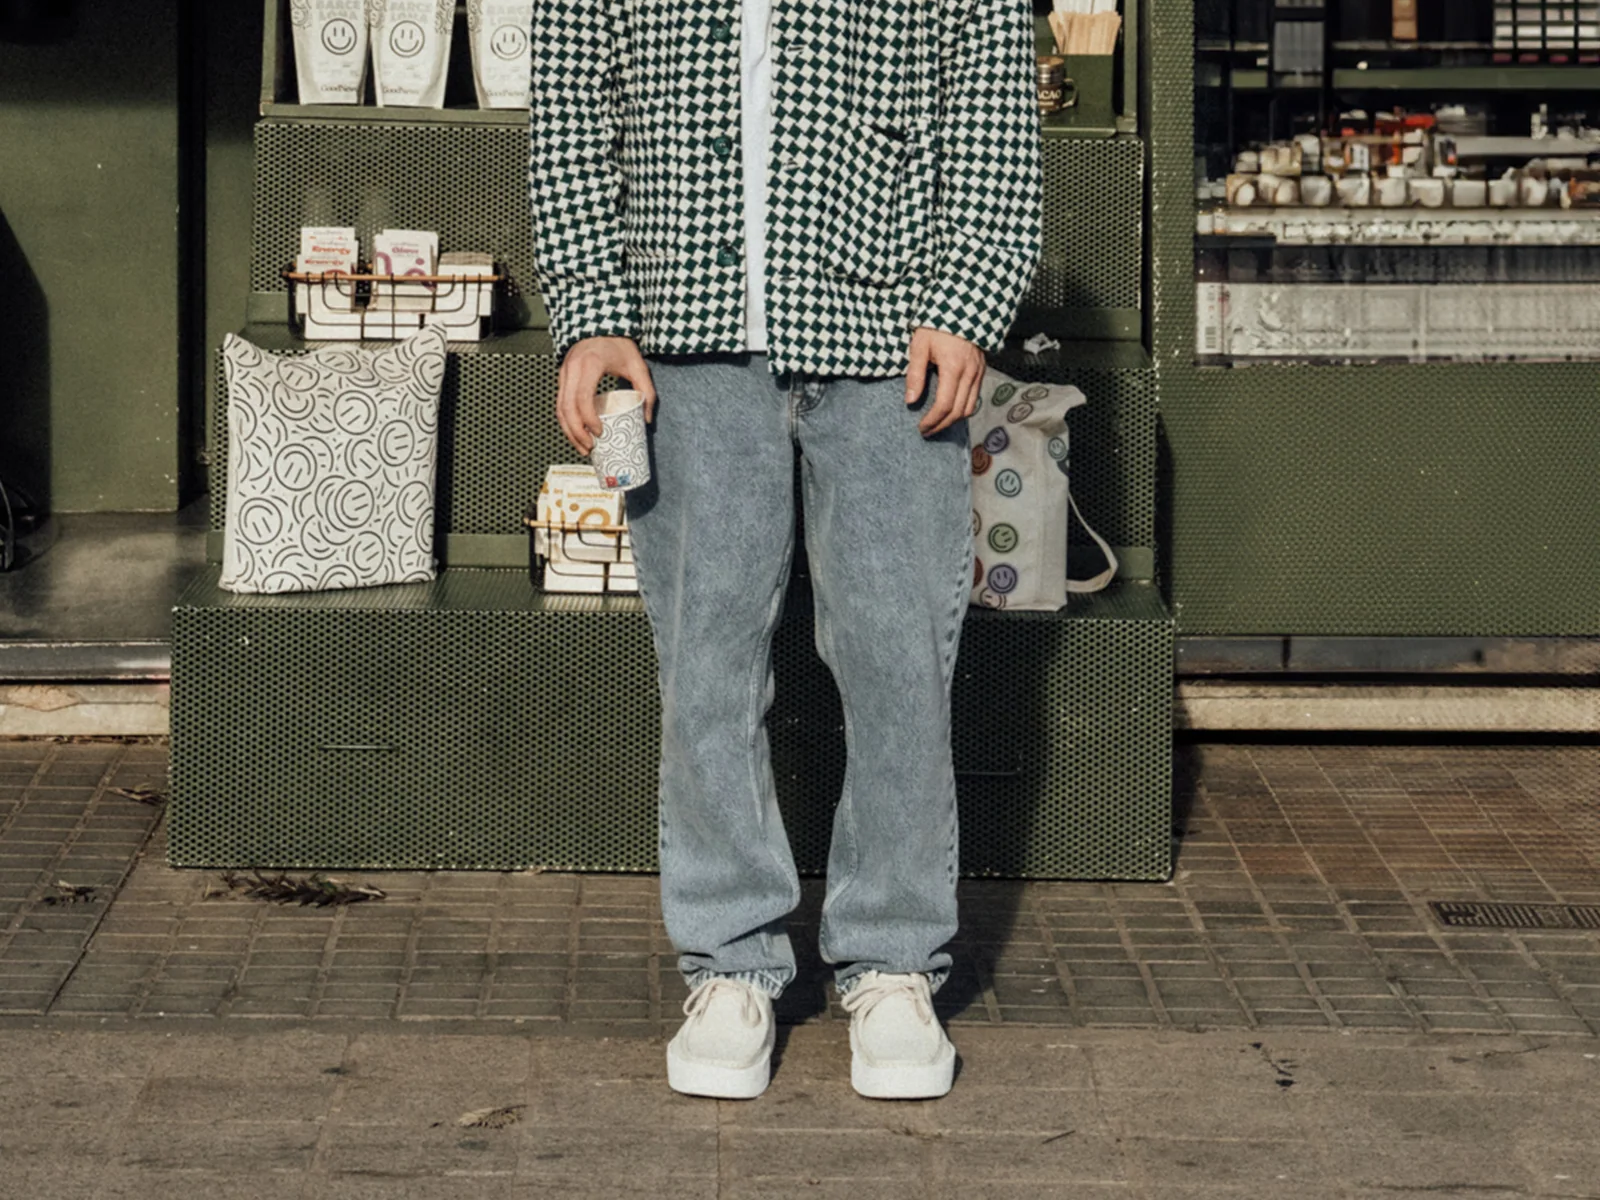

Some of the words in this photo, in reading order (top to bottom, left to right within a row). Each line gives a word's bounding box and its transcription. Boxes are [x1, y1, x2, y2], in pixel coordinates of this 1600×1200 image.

[315, 0, 361, 10] BARCE
[389, 1, 433, 13] BARCE
[319, 10, 358, 21] LONA
